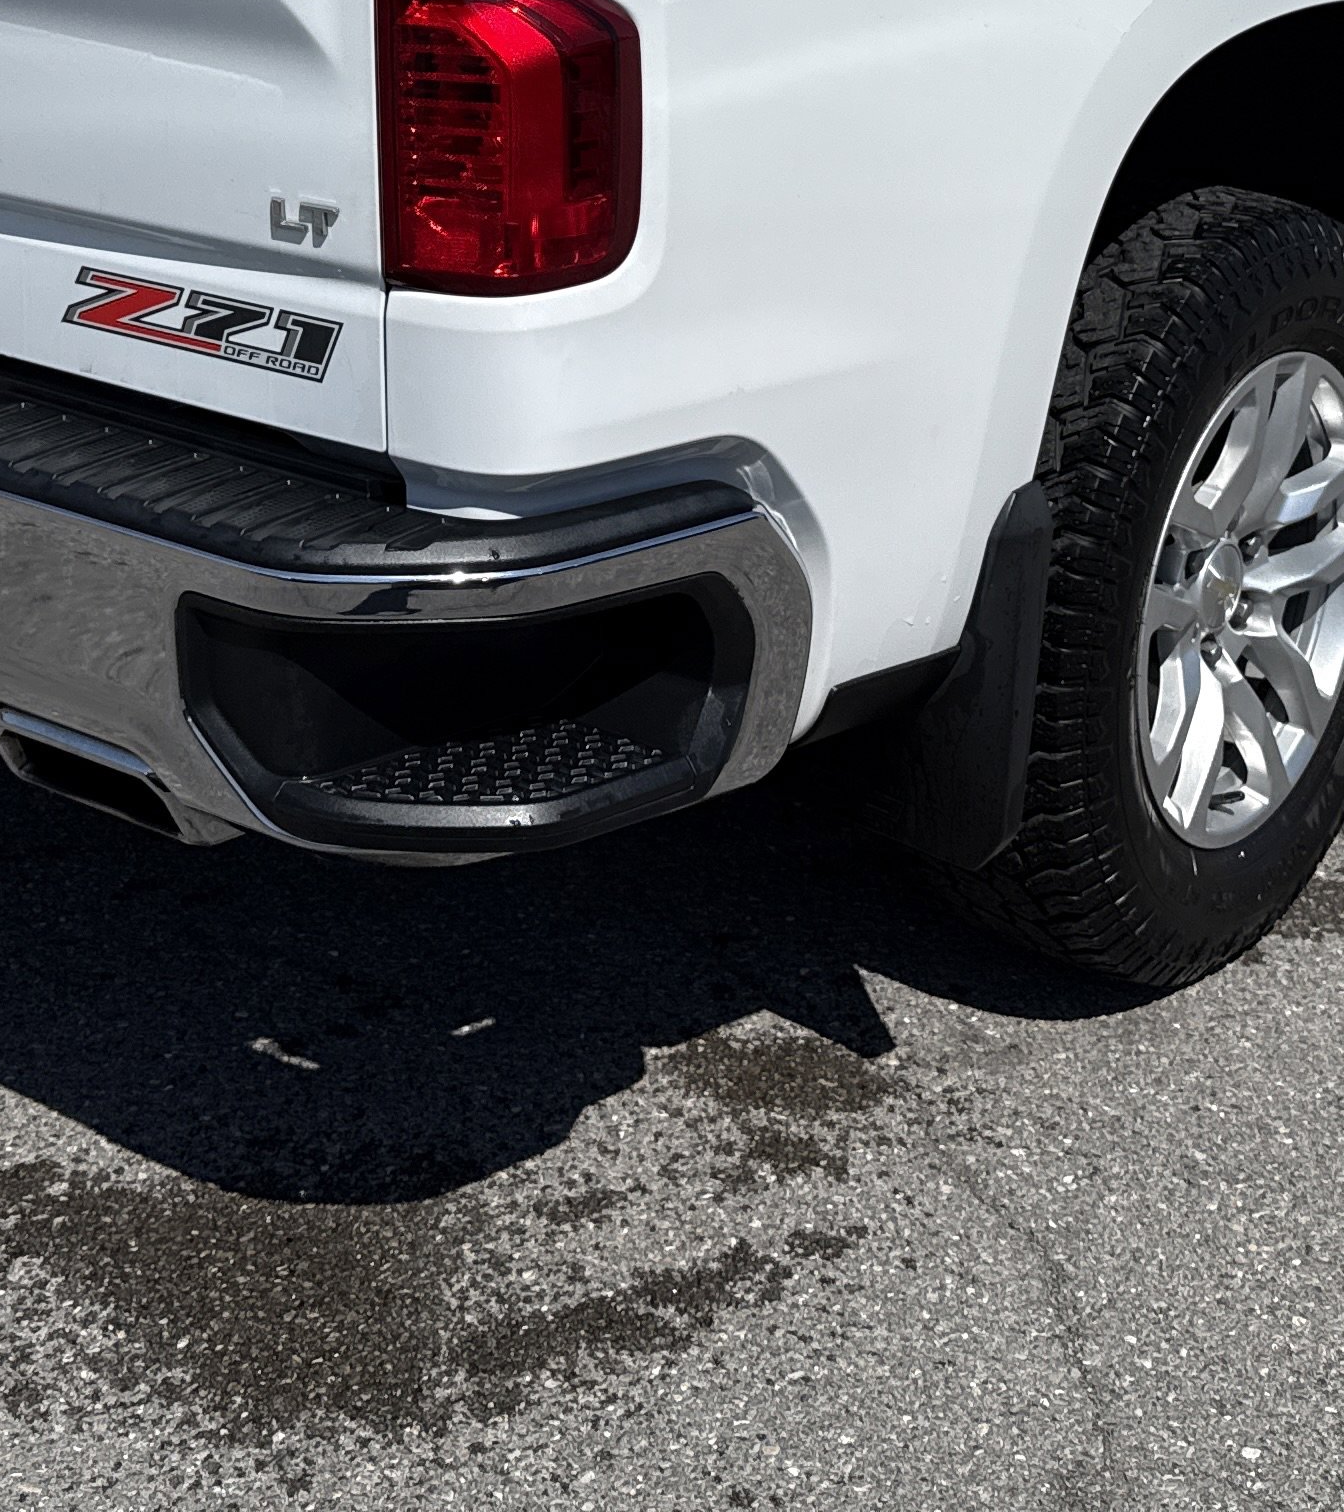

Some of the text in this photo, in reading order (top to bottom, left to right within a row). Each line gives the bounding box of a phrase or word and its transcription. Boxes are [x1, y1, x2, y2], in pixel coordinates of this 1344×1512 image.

[269, 196, 340, 246] LT
[61, 265, 344, 383] Z71
[223, 345, 320, 377] OFF ROAD
